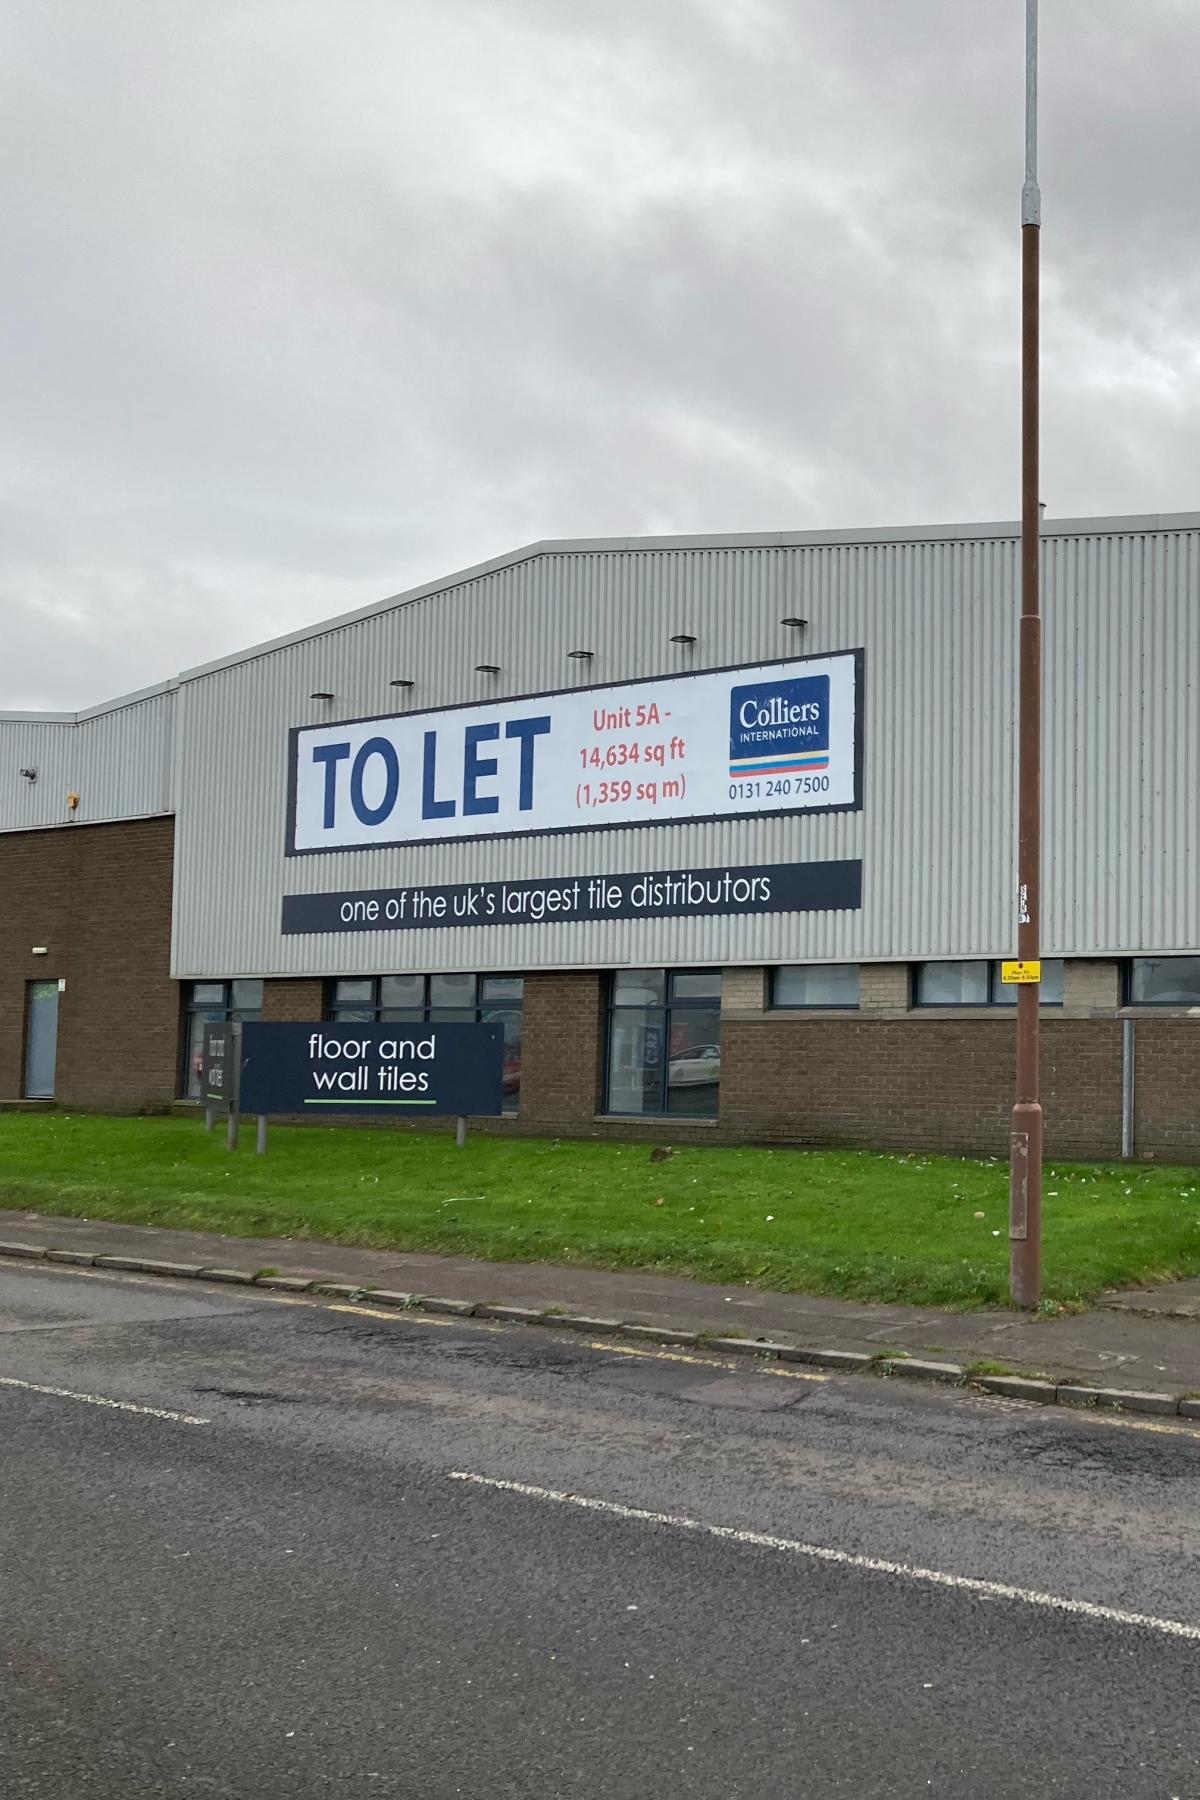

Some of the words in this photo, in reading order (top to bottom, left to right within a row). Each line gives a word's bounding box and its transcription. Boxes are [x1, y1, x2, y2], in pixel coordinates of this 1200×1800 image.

[593, 706, 631, 731] Unit
[636, 703, 660, 726] 5A
[740, 696, 819, 728] Colliers
[740, 725, 819, 743] INTERNATIONAL
[580, 742, 640, 770] 14,634
[644, 744, 664, 766] sq
[670, 736, 685, 760] ft
[313, 737, 399, 829] TO
[422, 716, 551, 820] LET
[729, 782, 761, 800] 0131
[766, 778, 791, 797] 240
[795, 775, 829, 794] 7500
[576, 780, 631, 808] (1,359
[637, 783, 657, 804] sq
[662, 773, 686, 799] m)
[340, 899, 379, 922] one
[385, 891, 407, 919] of
[412, 891, 447, 918] the
[453, 886, 495, 917] uk's
[502, 881, 580, 920] largest
[588, 878, 622, 909] tile
[631, 872, 771, 907] distributors
[309, 1033, 372, 1059] floor
[379, 1034, 436, 1059] and
[312, 1065, 369, 1091] wall
[377, 1065, 429, 1092] tiles
